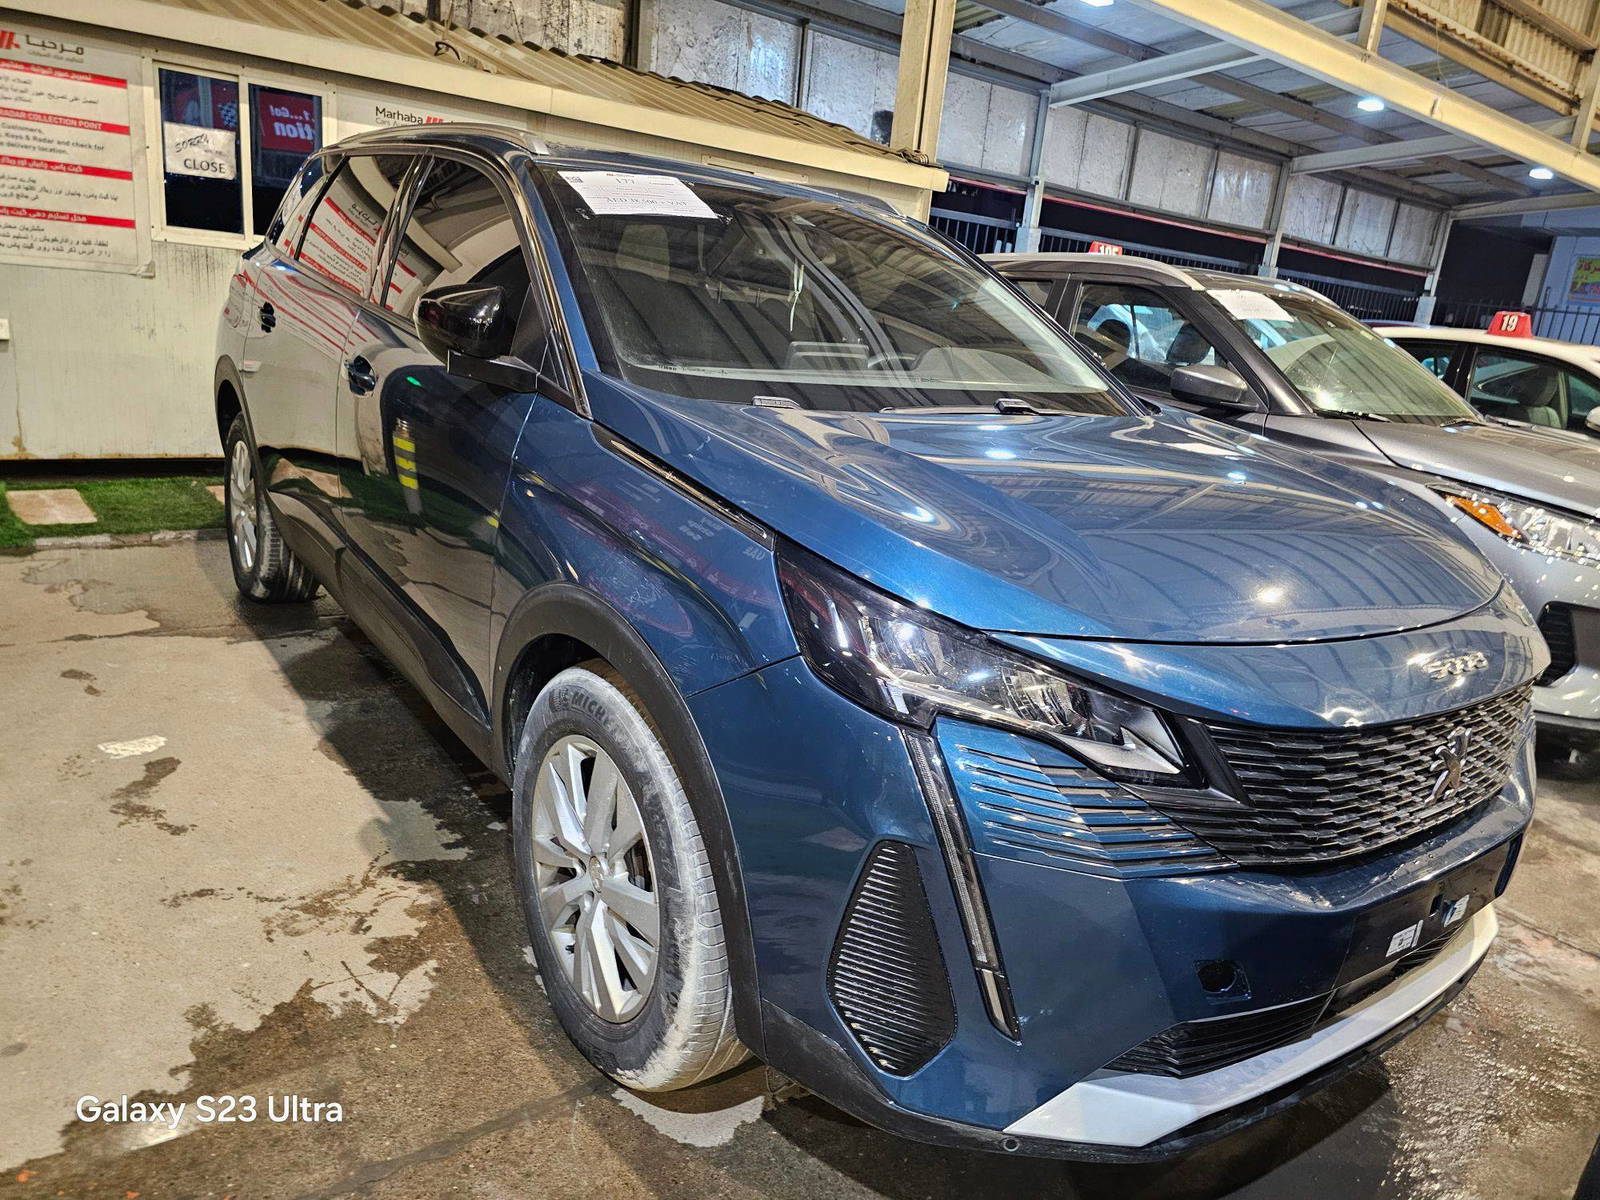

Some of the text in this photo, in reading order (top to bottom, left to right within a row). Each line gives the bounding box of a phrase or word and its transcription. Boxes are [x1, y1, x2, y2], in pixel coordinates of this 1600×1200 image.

[27, 112, 77, 126] COLLECTION
[79, 120, 102, 130] POINT
[375, 106, 424, 126] Marhaba
[184, 158, 226, 174] CLOSE
[1501, 314, 1519, 332] 19
